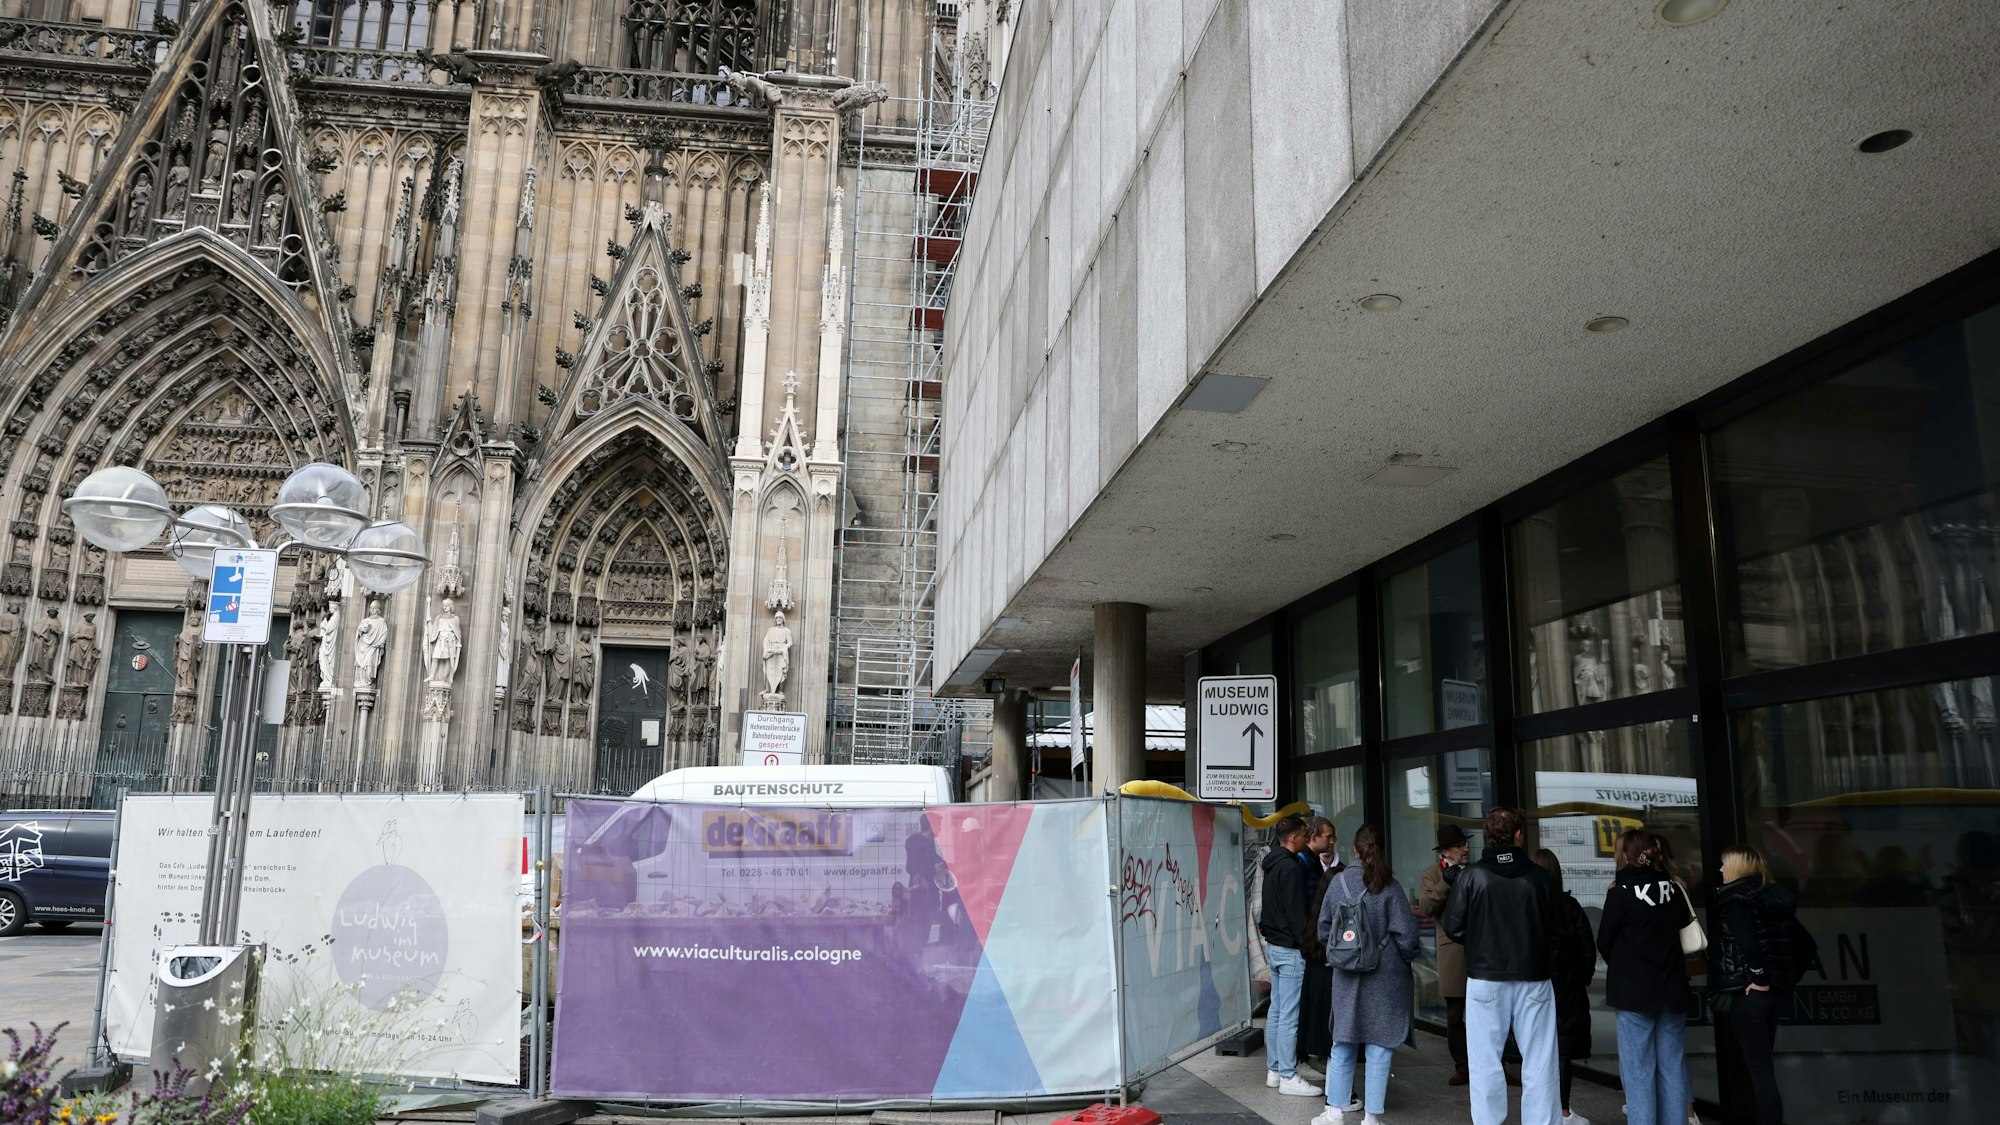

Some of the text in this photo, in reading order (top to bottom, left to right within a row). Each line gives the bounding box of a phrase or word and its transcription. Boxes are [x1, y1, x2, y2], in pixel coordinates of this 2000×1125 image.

[1205, 686, 1269, 698] MUSEUM
[1210, 703, 1269, 716] LUDWIG
[757, 714, 795, 725] Durchgang
[751, 731, 797, 742] Bahnhofsvorplatz
[758, 741, 789, 750] gesperrt
[713, 783, 844, 796] BAUTENSCHUTZ
[158, 828, 174, 837] Wir
[176, 828, 204, 837] halten
[266, 828, 322, 838] Laufenden!
[706, 814, 842, 847] deGraaff
[287, 864, 297, 872] Sie
[720, 868, 737, 878] Tel.
[739, 868, 762, 878] 0228
[770, 868, 783, 877] 46
[784, 868, 796, 877] 70
[798, 868, 810, 877] 01
[823, 866, 903, 878] www.degraaff.de
[190, 884, 203, 892] Dom
[34, 905, 96, 914] www.hees-knoll.de
[340, 902, 418, 946] Ludwig
[393, 929, 412, 947] im
[633, 943, 863, 966] www.viaculturalis.cologne
[1817, 991, 1857, 1003] GMBH
[418, 1034, 437, 1042] 10-24
[1838, 1090, 1860, 1103] Ein
[1863, 1090, 1925, 1103] Museum
